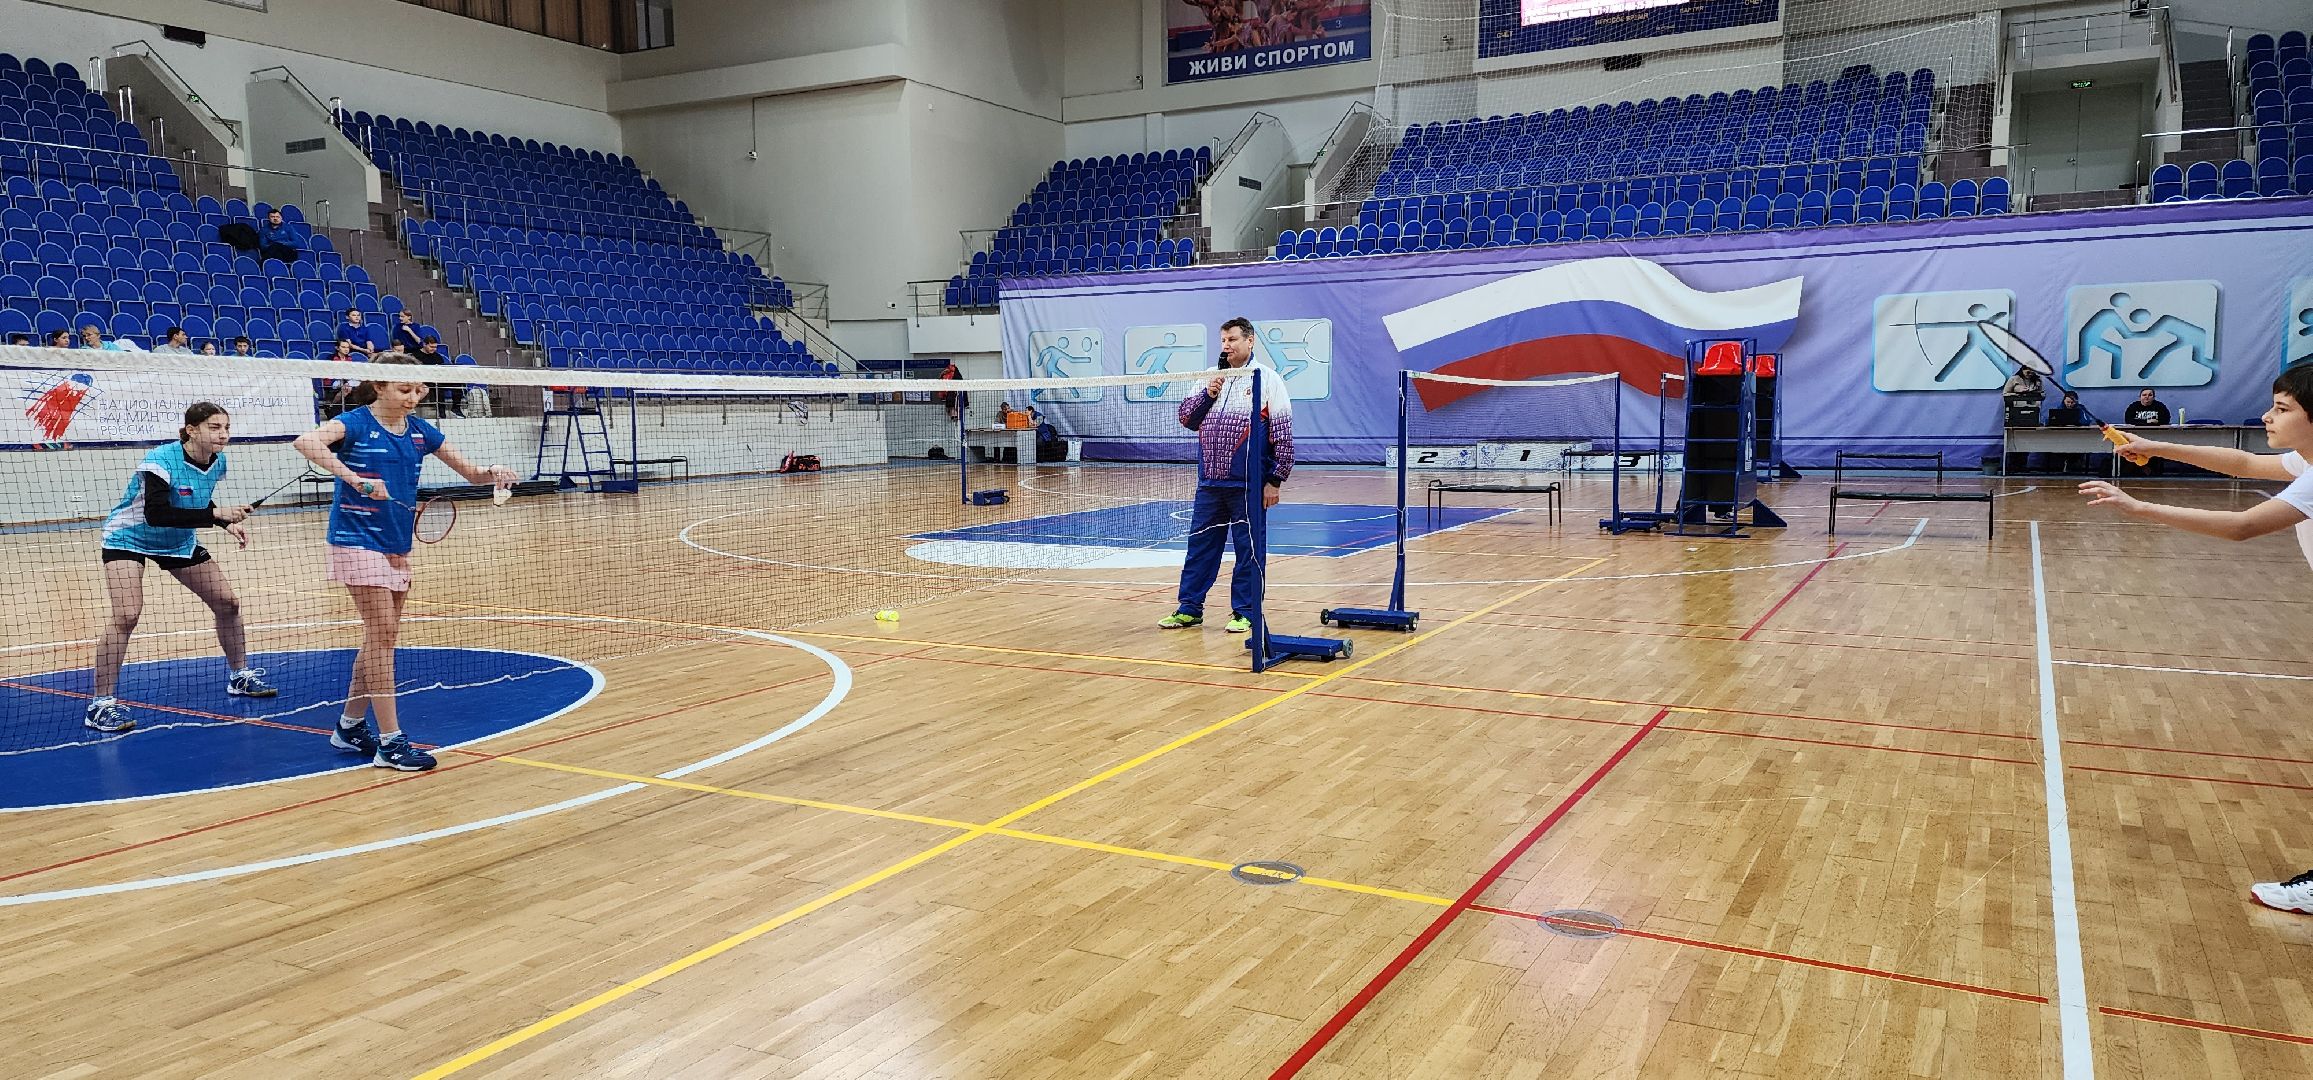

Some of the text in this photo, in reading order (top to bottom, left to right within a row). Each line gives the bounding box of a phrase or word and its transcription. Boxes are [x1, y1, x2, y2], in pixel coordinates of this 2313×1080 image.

[1189, 40, 1355, 76] ЖИВИ СПОРТОМ
[100, 424, 156, 436] РОССИИ
[1417, 451, 1438, 464] 2
[1519, 449, 1531, 462] 1
[1618, 455, 1641, 467] 3
